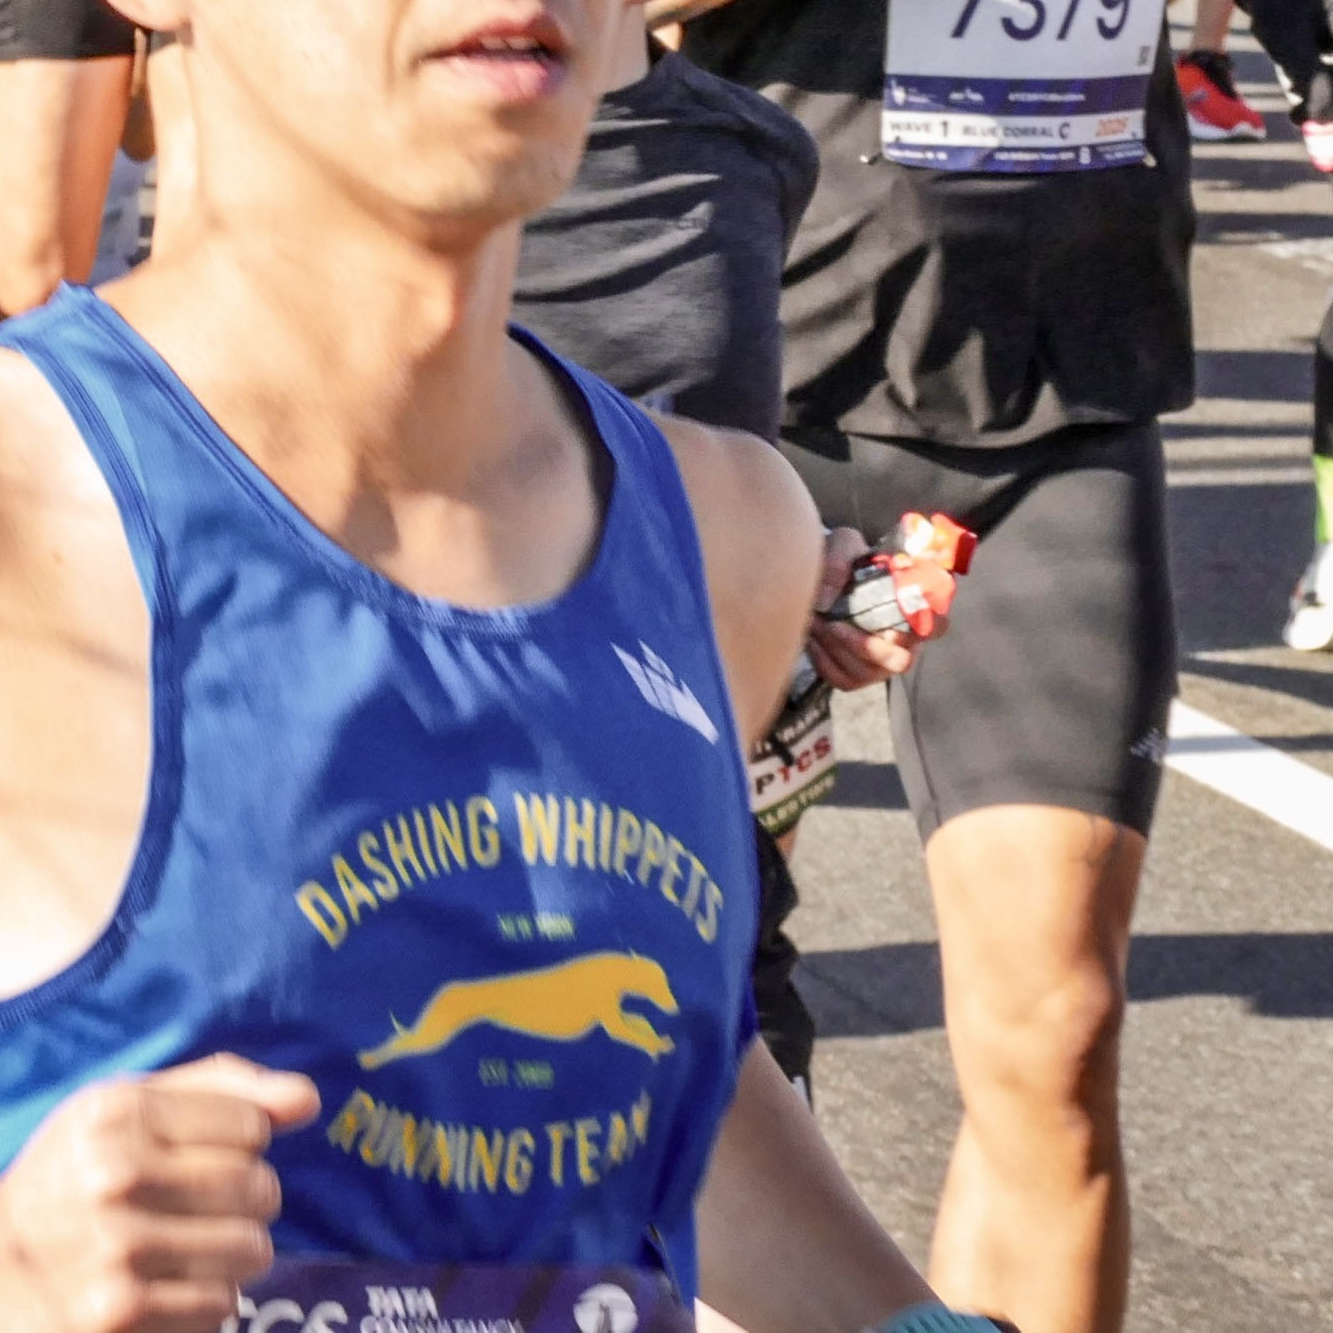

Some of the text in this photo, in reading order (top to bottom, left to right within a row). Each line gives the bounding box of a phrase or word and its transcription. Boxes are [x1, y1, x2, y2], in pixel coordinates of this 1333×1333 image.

[1058, 122, 1072, 140] C
[294, 791, 725, 951] DASHING WHIPPETS
[326, 1086, 536, 1196] RUNNING
